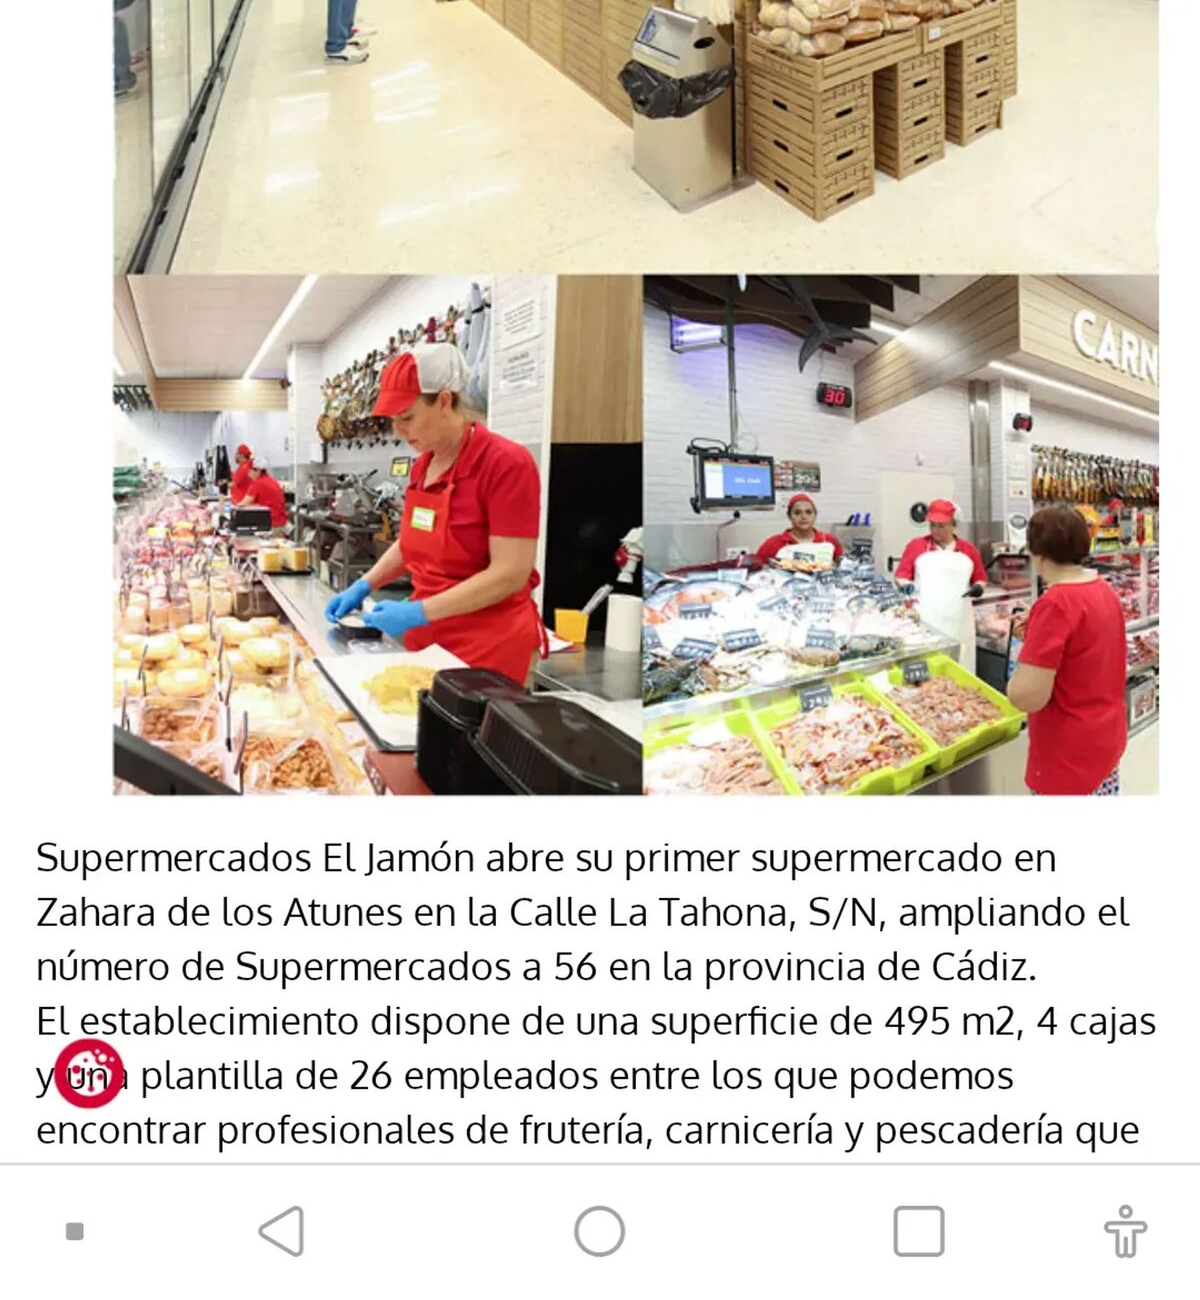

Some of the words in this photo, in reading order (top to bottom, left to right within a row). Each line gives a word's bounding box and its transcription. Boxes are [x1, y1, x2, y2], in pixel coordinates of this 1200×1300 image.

[1072, 308, 1159, 387] CARN
[824, 388, 846, 405] 30
[36, 841, 312, 882] Supermercados
[324, 841, 357, 873] El
[363, 839, 474, 877] Jamón
[486, 841, 565, 873] abre
[576, 849, 613, 873] su
[625, 842, 741, 882] primer
[751, 841, 1003, 882] supermercado
[1014, 849, 1056, 873] en
[36, 896, 155, 927] Zahara
[167, 896, 211, 927] de
[222, 896, 273, 927] los
[282, 897, 403, 927] Atunes
[414, 903, 456, 927] en
[468, 896, 497, 927] la
[510, 895, 597, 927] Calle
[610, 897, 647, 927] La
[658, 896, 796, 933] Tahona,
[809, 896, 886, 933] S/N,
[899, 895, 1086, 936] ampliando
[1097, 896, 1131, 927] el
[37, 948, 170, 982] número
[181, 950, 225, 981] de
[236, 950, 512, 990] Supermercados
[522, 958, 541, 982] a
[554, 951, 597, 981] 56
[609, 958, 651, 982] en
[663, 950, 692, 982] la
[705, 951, 865, 990] provincia
[877, 950, 921, 982] de
[932, 948, 1036, 982] Cádiz.
[38, 1004, 71, 1036] El
[80, 1004, 359, 1036] establecimiento
[370, 1004, 511, 1045] dispone
[522, 1004, 565, 1036] de
[576, 1012, 638, 1036] una
[651, 1004, 818, 1045] superficie
[829, 1004, 873, 1036] de
[884, 1005, 950, 1036] 495
[962, 1004, 1024, 1042] m2,
[1036, 1006, 1058, 1036] 4
[1069, 1006, 1157, 1045] cajas
[35, 1067, 55, 1099] y
[142, 1059, 283, 1099] plantilla
[295, 1059, 339, 1091] de
[350, 1059, 393, 1090] 26
[404, 1059, 599, 1099] empleados
[609, 1062, 700, 1090] entre
[712, 1059, 763, 1090] los
[774, 1067, 838, 1099] que
[850, 1059, 1014, 1099] podemos
[37, 1116, 207, 1145] encontrar
[218, 1113, 455, 1154] profesionales
[466, 1113, 509, 1145] de
[519, 1111, 653, 1150] frutería,
[665, 1112, 833, 1145] carnicería
[844, 1121, 865, 1154] y
[876, 1112, 1063, 1154] pescadería
[1075, 1121, 1140, 1154] que
